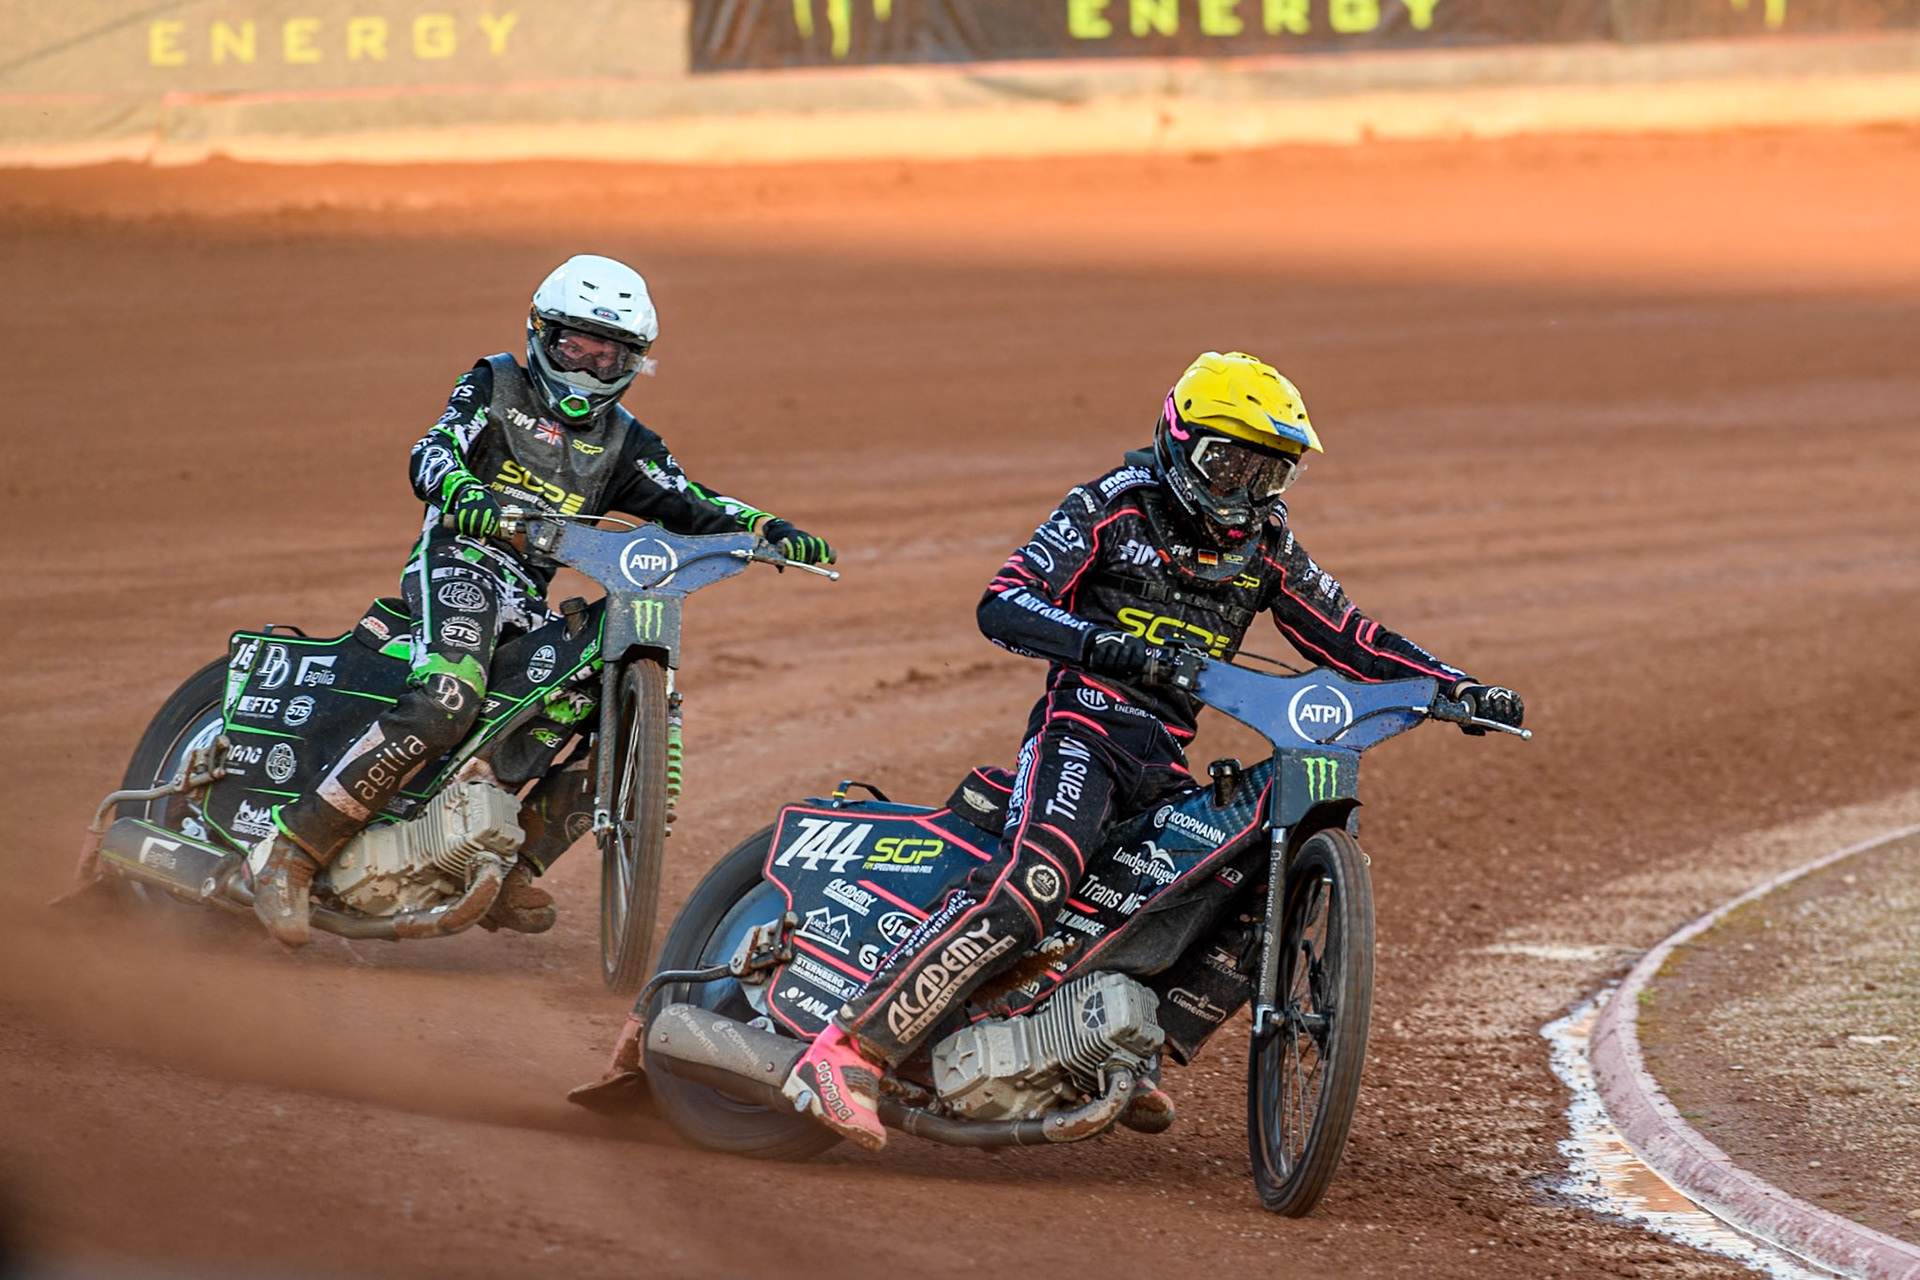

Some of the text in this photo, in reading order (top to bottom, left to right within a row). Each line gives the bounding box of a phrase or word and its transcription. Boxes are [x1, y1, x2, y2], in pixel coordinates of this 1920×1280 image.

[1067, 0, 1437, 39] ENERGY
[149, 14, 518, 67] ENERGY
[629, 554, 668, 572] ATPI
[444, 625, 479, 643] STS
[304, 669, 336, 687] agilia
[1299, 703, 1341, 725] ATPI
[354, 734, 427, 800] agilia
[1045, 760, 1089, 820] Trans
[775, 817, 944, 873] 744 SGP
[1168, 811, 1227, 844] KOOPMANN
[1112, 846, 1182, 886] Landgeflügel
[827, 877, 878, 908] ACADEMY
[1079, 873, 1123, 909] Trans
[794, 955, 846, 989] STERNBERG
[886, 917, 998, 1037] ACADEMY
[815, 1059, 855, 1122] daytona
